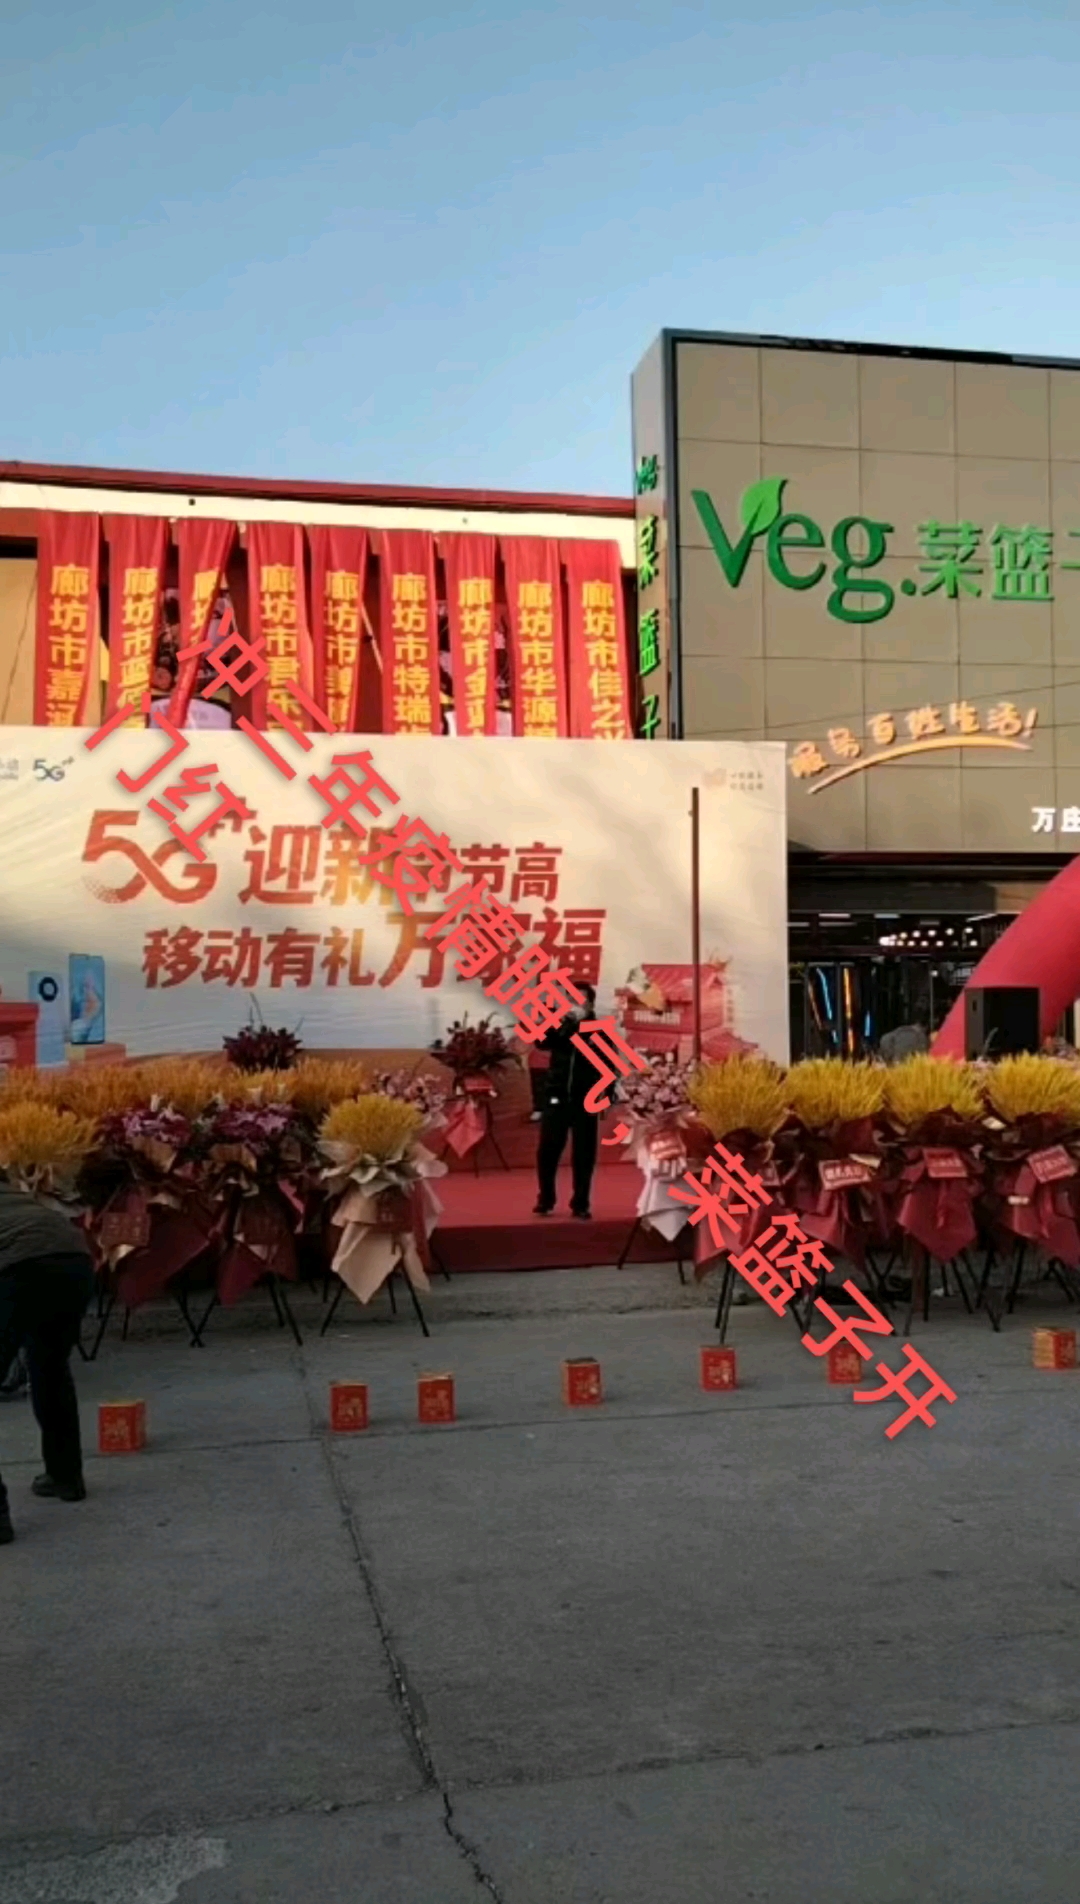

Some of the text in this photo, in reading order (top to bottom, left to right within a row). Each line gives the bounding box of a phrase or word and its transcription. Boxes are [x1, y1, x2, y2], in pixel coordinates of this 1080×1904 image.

[260, 564, 303, 733] 廊坊市君乐
